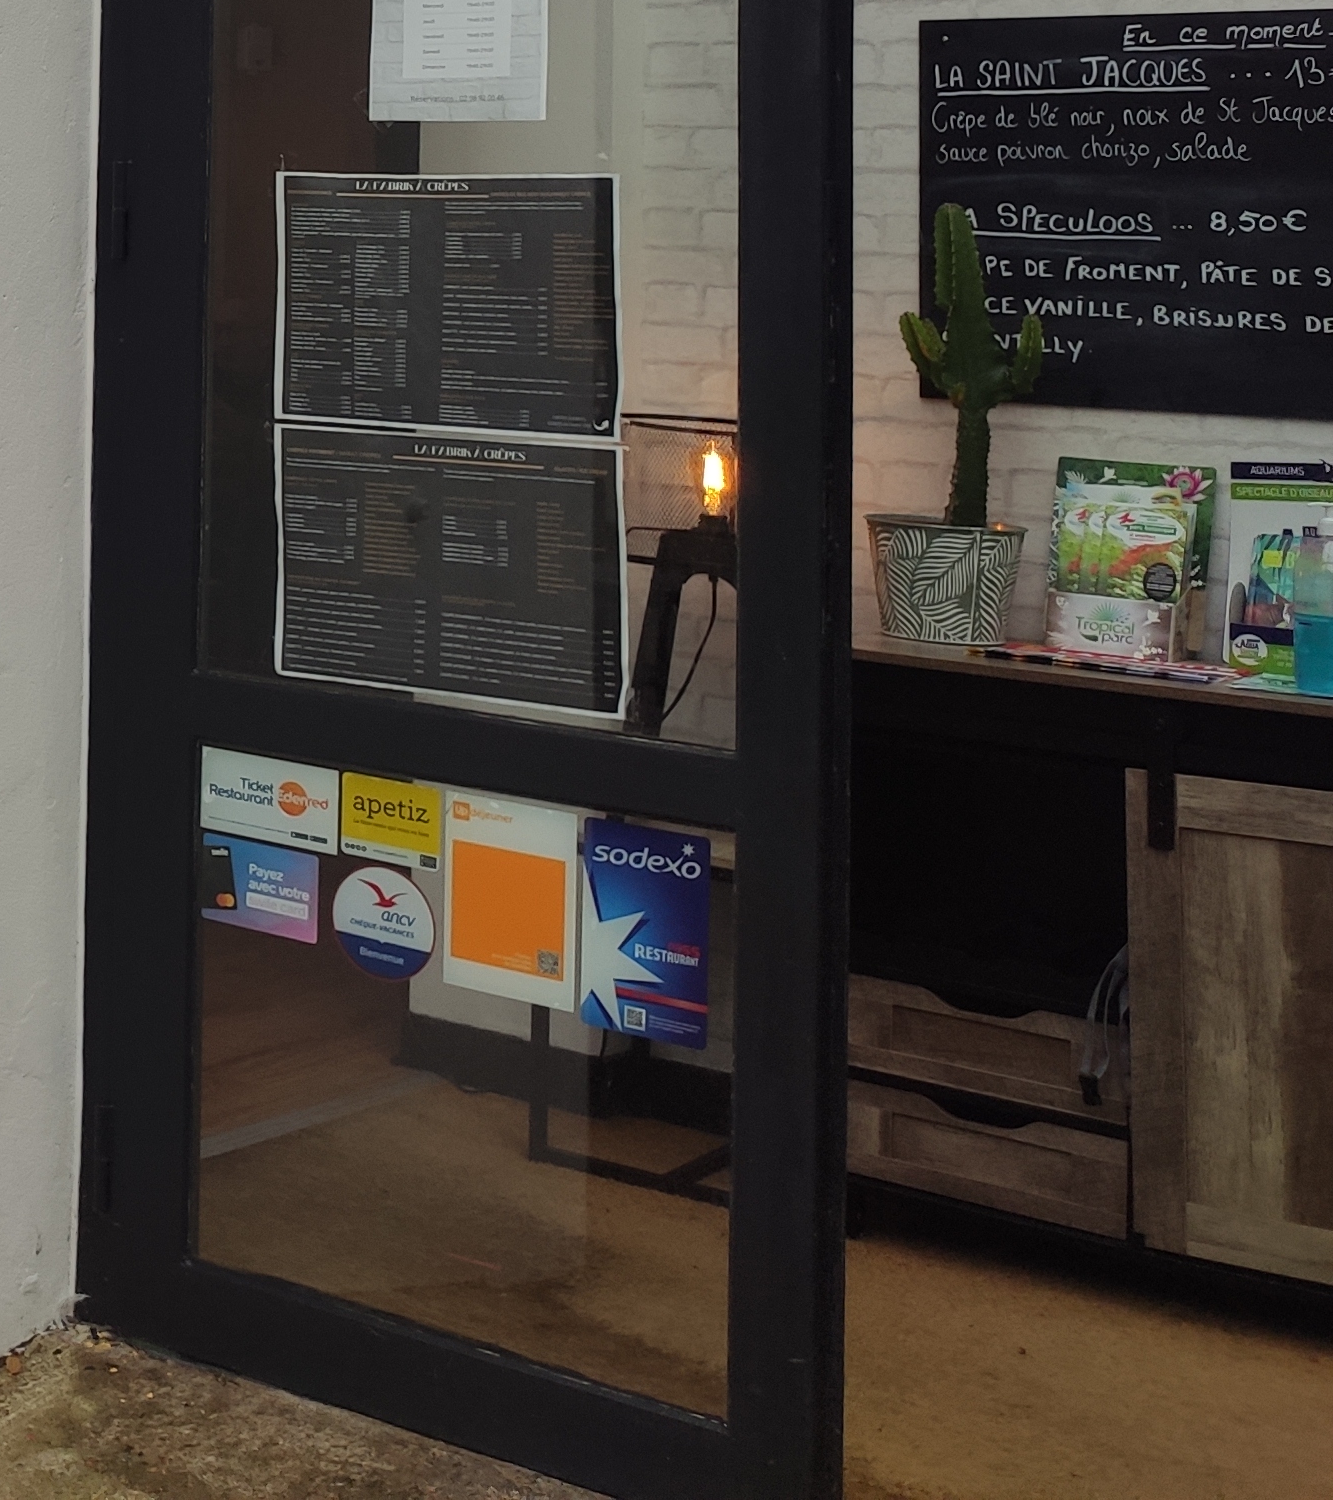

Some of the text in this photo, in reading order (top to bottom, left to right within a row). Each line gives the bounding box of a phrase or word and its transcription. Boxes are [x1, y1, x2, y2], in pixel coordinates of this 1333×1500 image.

[1122, 18, 1323, 49] En ce moment
[935, 55, 1333, 90] LA SAINT JACQUES 13
[932, 101, 987, 137] Crêpe
[995, 105, 1018, 128] de
[1028, 102, 1058, 127] blé
[1071, 106, 1114, 136] noir,
[1123, 106, 1170, 126] noix
[1181, 100, 1205, 124] de
[1217, 97, 1241, 122] St
[936, 142, 987, 164] sauce
[997, 140, 1070, 167] poivron
[1165, 131, 1252, 162] salade
[997, 203, 1154, 233] SPECULOOS
[1210, 209, 1307, 236] 8,50€
[1024, 258, 1054, 277] DE
[1065, 255, 1188, 288] FROMENT,
[1201, 260, 1258, 286] PÂTE
[1272, 268, 1302, 286] DE
[1305, 315, 1333, 334] DE
[1249, 464, 1305, 477] AQUARIUMS
[1235, 486, 1287, 498] SPECTACLE
[1076, 616, 1135, 635] Tropical
[1101, 633, 1133, 645] parc
[209, 783, 329, 810] Restaurant Edenred
[240, 777, 274, 794] Ticket
[353, 795, 430, 824] apetiz
[248, 863, 284, 882] Payez
[592, 844, 702, 880] sodexo
[248, 879, 310, 902] avec votre
[381, 910, 416, 927] ancv
[635, 943, 699, 968] RESTAURANT
